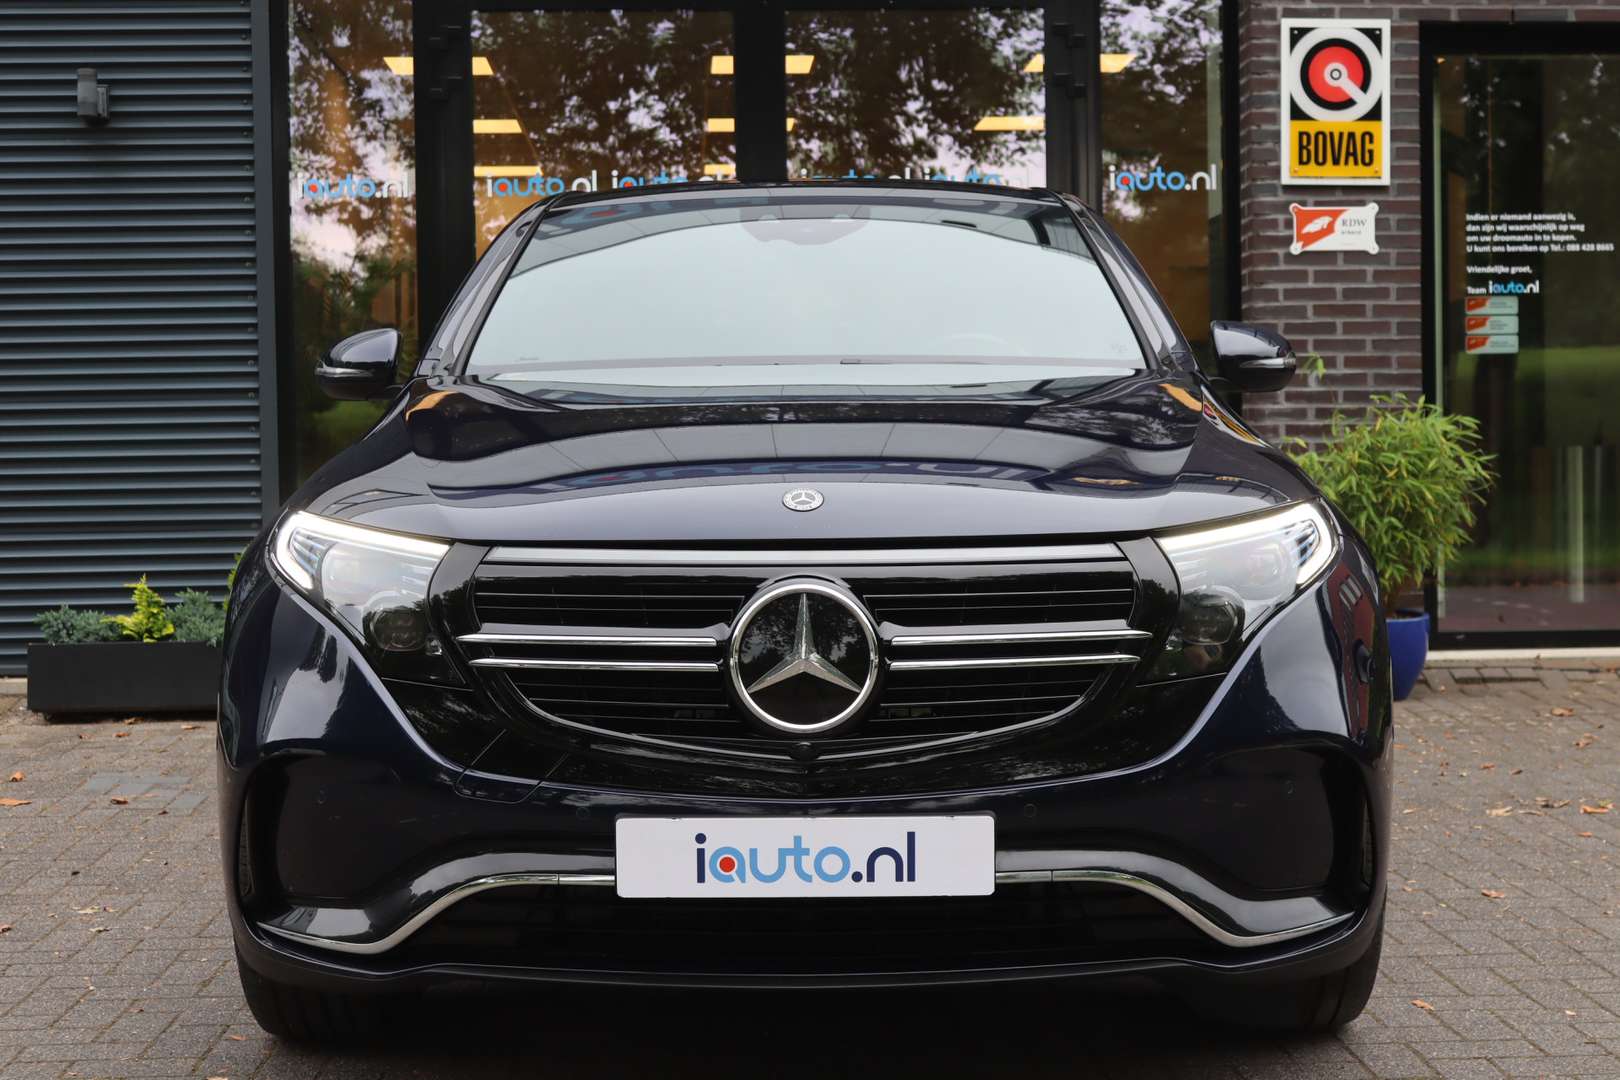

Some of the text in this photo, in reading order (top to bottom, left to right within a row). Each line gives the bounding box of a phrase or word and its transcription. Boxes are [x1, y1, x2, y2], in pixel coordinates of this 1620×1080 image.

[1298, 131, 1374, 167] BOVAG
[297, 172, 409, 199] iauto.nl
[487, 169, 598, 197] iautonl
[1108, 163, 1217, 192] iauto.nl
[1342, 218, 1367, 227] RDW
[1466, 264, 1509, 274] Vriendelijke
[1467, 279, 1540, 294] Team iauto.nl
[694, 831, 916, 884] iauto.nl
